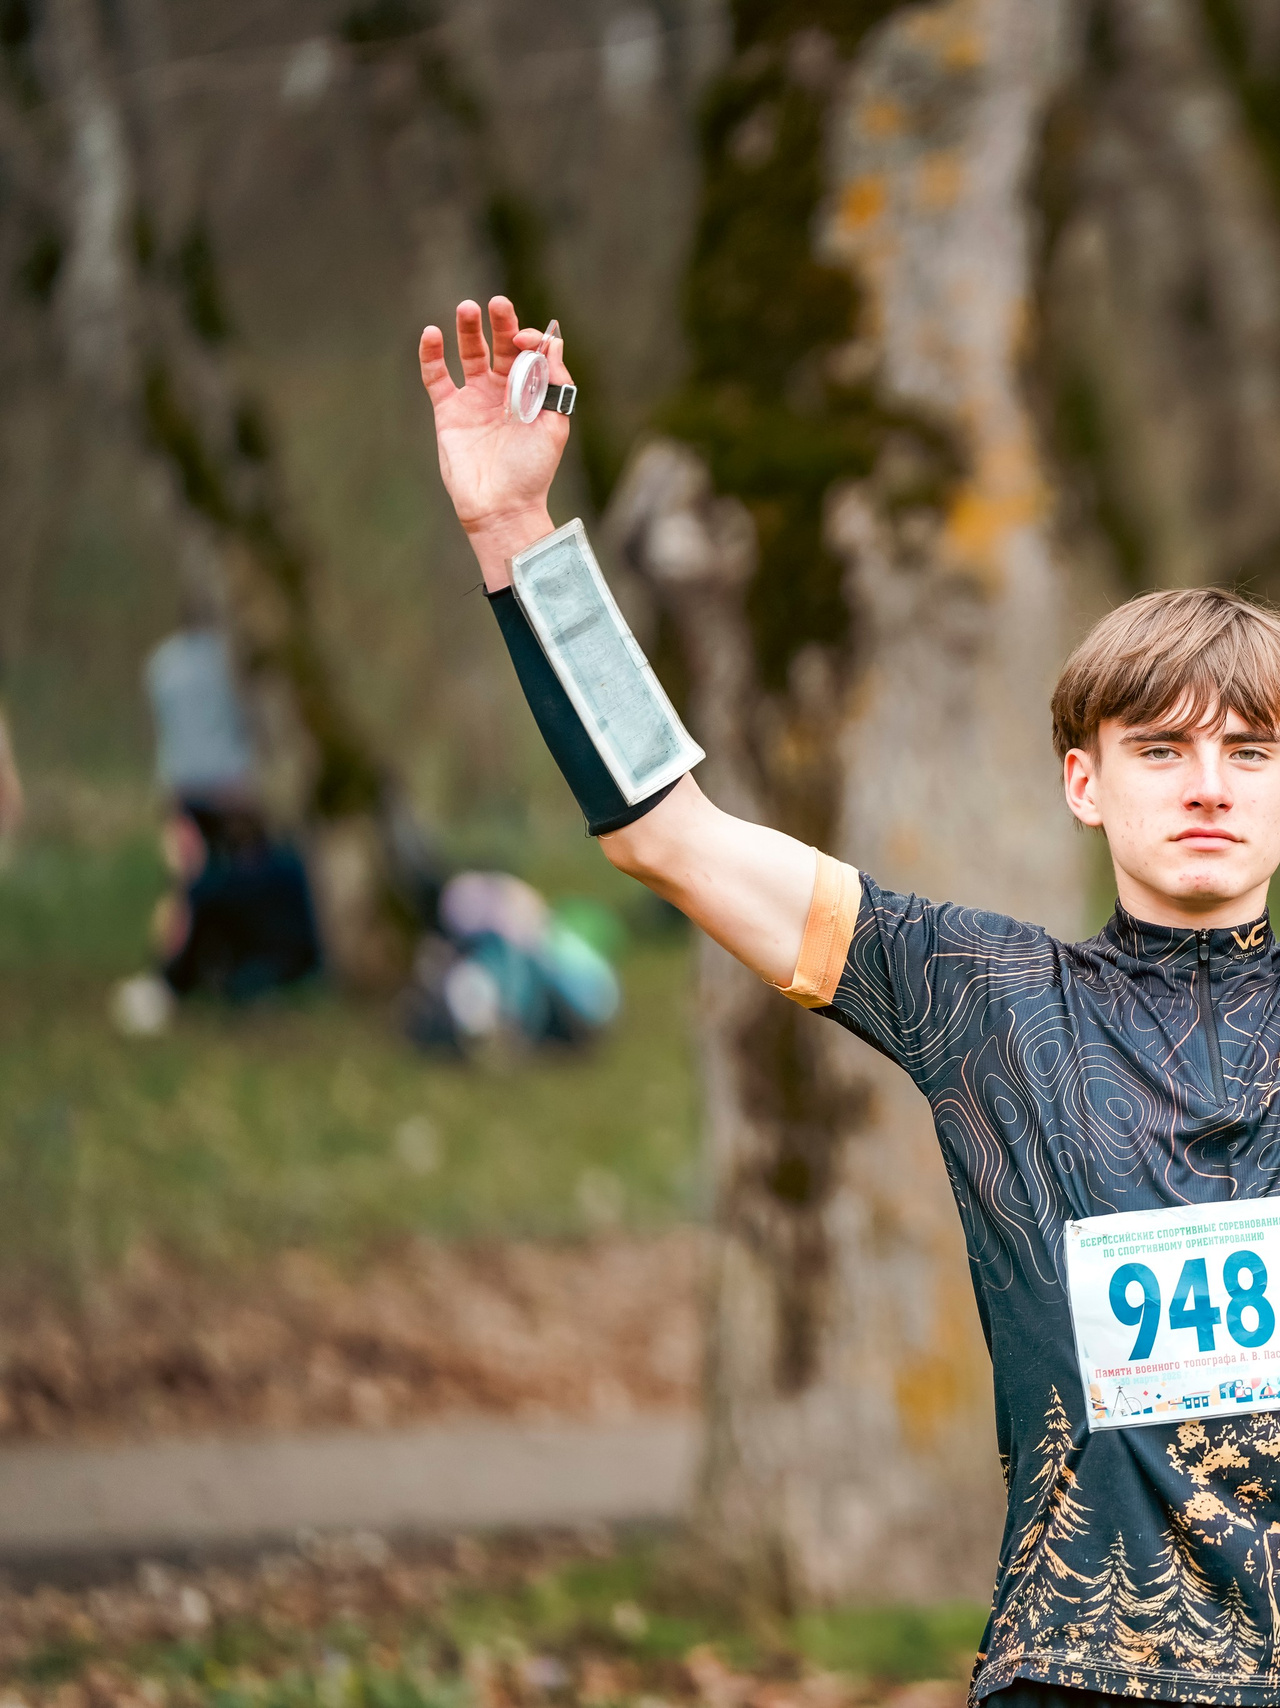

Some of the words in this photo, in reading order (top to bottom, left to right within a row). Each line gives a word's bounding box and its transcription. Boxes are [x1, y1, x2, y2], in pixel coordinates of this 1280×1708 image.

[1231, 920, 1267, 950] VC
[1080, 1231, 1155, 1248] ВСЕРОССИЙСКИЕ
[1157, 1223, 1217, 1239] СПОРТИВНЫЕ
[1103, 1248, 1116, 1258] ПО
[1118, 1240, 1182, 1257] СПОРТИВНОМУ
[1185, 1231, 1265, 1249] ОРИЕНТИРОВАНИЮ
[1109, 1250, 1275, 1361] 948
[1095, 1367, 1132, 1379] Памяти
[1135, 1361, 1180, 1374] военного
[1183, 1353, 1237, 1368] топографа
[1240, 1352, 1249, 1362] А.
[1252, 1351, 1261, 1361] В.
